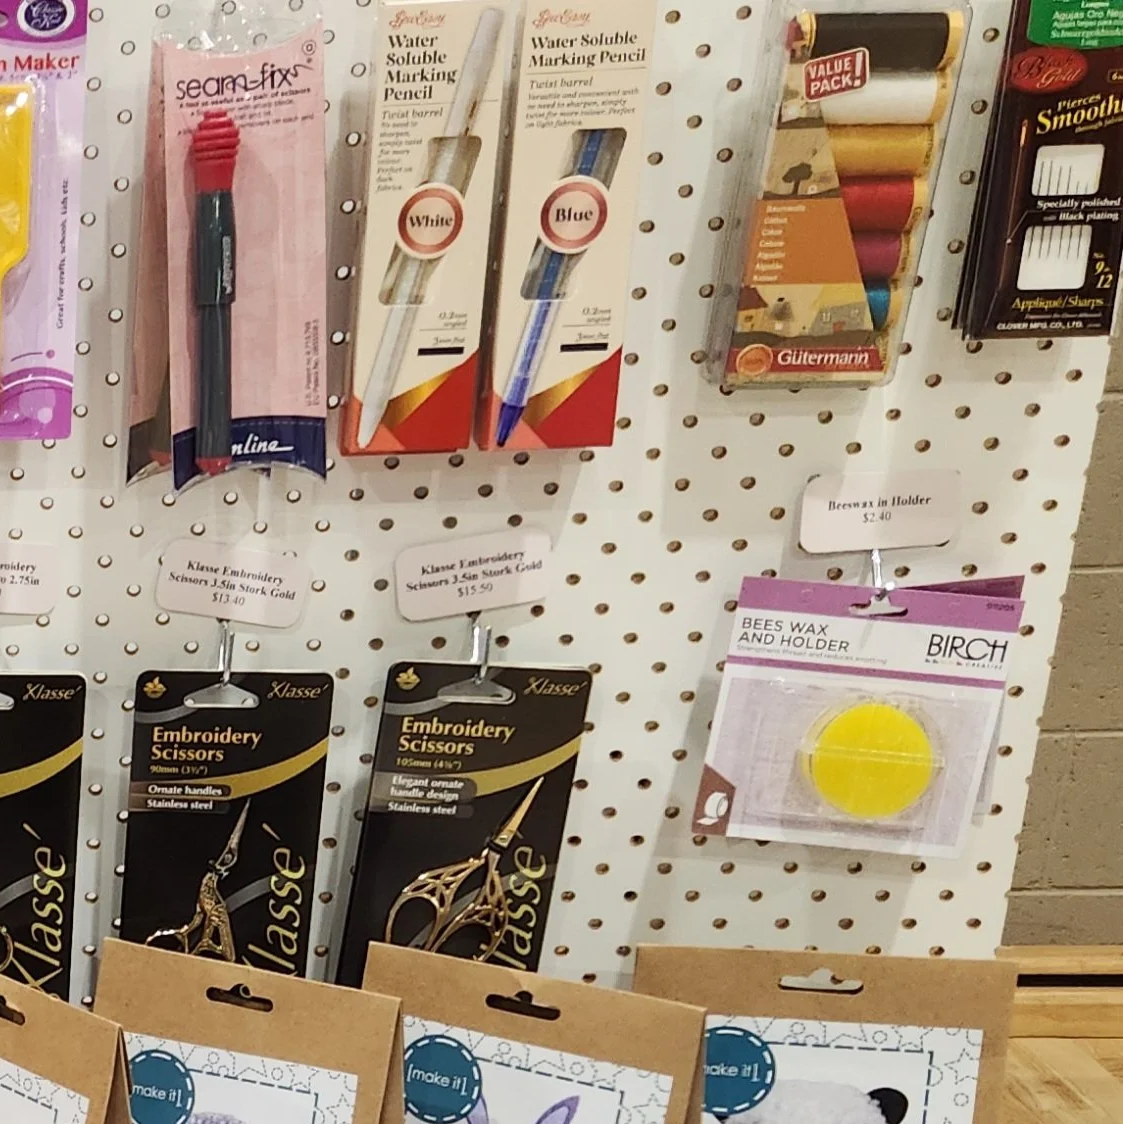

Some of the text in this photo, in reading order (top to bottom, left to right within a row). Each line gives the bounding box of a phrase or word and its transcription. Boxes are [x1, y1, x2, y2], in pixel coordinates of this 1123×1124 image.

[388, 34, 438, 48] Water
[531, 31, 638, 50] Water Soluble
[14, 53, 80, 70] Maker
[386, 51, 447, 66] Soluble
[528, 48, 646, 69] Marking Pencil
[808, 56, 853, 78] VALUE
[176, 62, 294, 100] seam-fix
[384, 67, 457, 86] Marking
[383, 84, 433, 101] Pencil
[1057, 94, 1101, 111] Pierces
[1037, 198, 1121, 210] Specially polished
[409, 214, 453, 228] White
[555, 206, 594, 223] Blue
[1096, 275, 1113, 288] 12
[777, 347, 869, 367] Gütermann
[828, 493, 932, 511] Beeswax in Holder
[863, 510, 892, 523] $2.40
[421, 551, 525, 576] Klasse Embroidery
[187, 560, 284, 586] Klasse Embroidery
[168, 571, 296, 601] Scissors 3.5in Stork Gold
[741, 617, 829, 636] BEES WAX
[737, 631, 775, 646] AND
[780, 635, 850, 653] HOLDER
[926, 633, 1008, 664] BIRCH
[152, 726, 262, 750] Embroidery
[402, 717, 515, 744] Embroidery
[151, 744, 224, 762] Scissors
[399, 735, 475, 756] Scissors
[148, 785, 222, 796] Ornate handles
[392, 775, 464, 789] Elegant ornate
[390, 786, 459, 801] handle design
[147, 799, 213, 810] Stainless steel
[387, 801, 457, 815] Stainless steel
